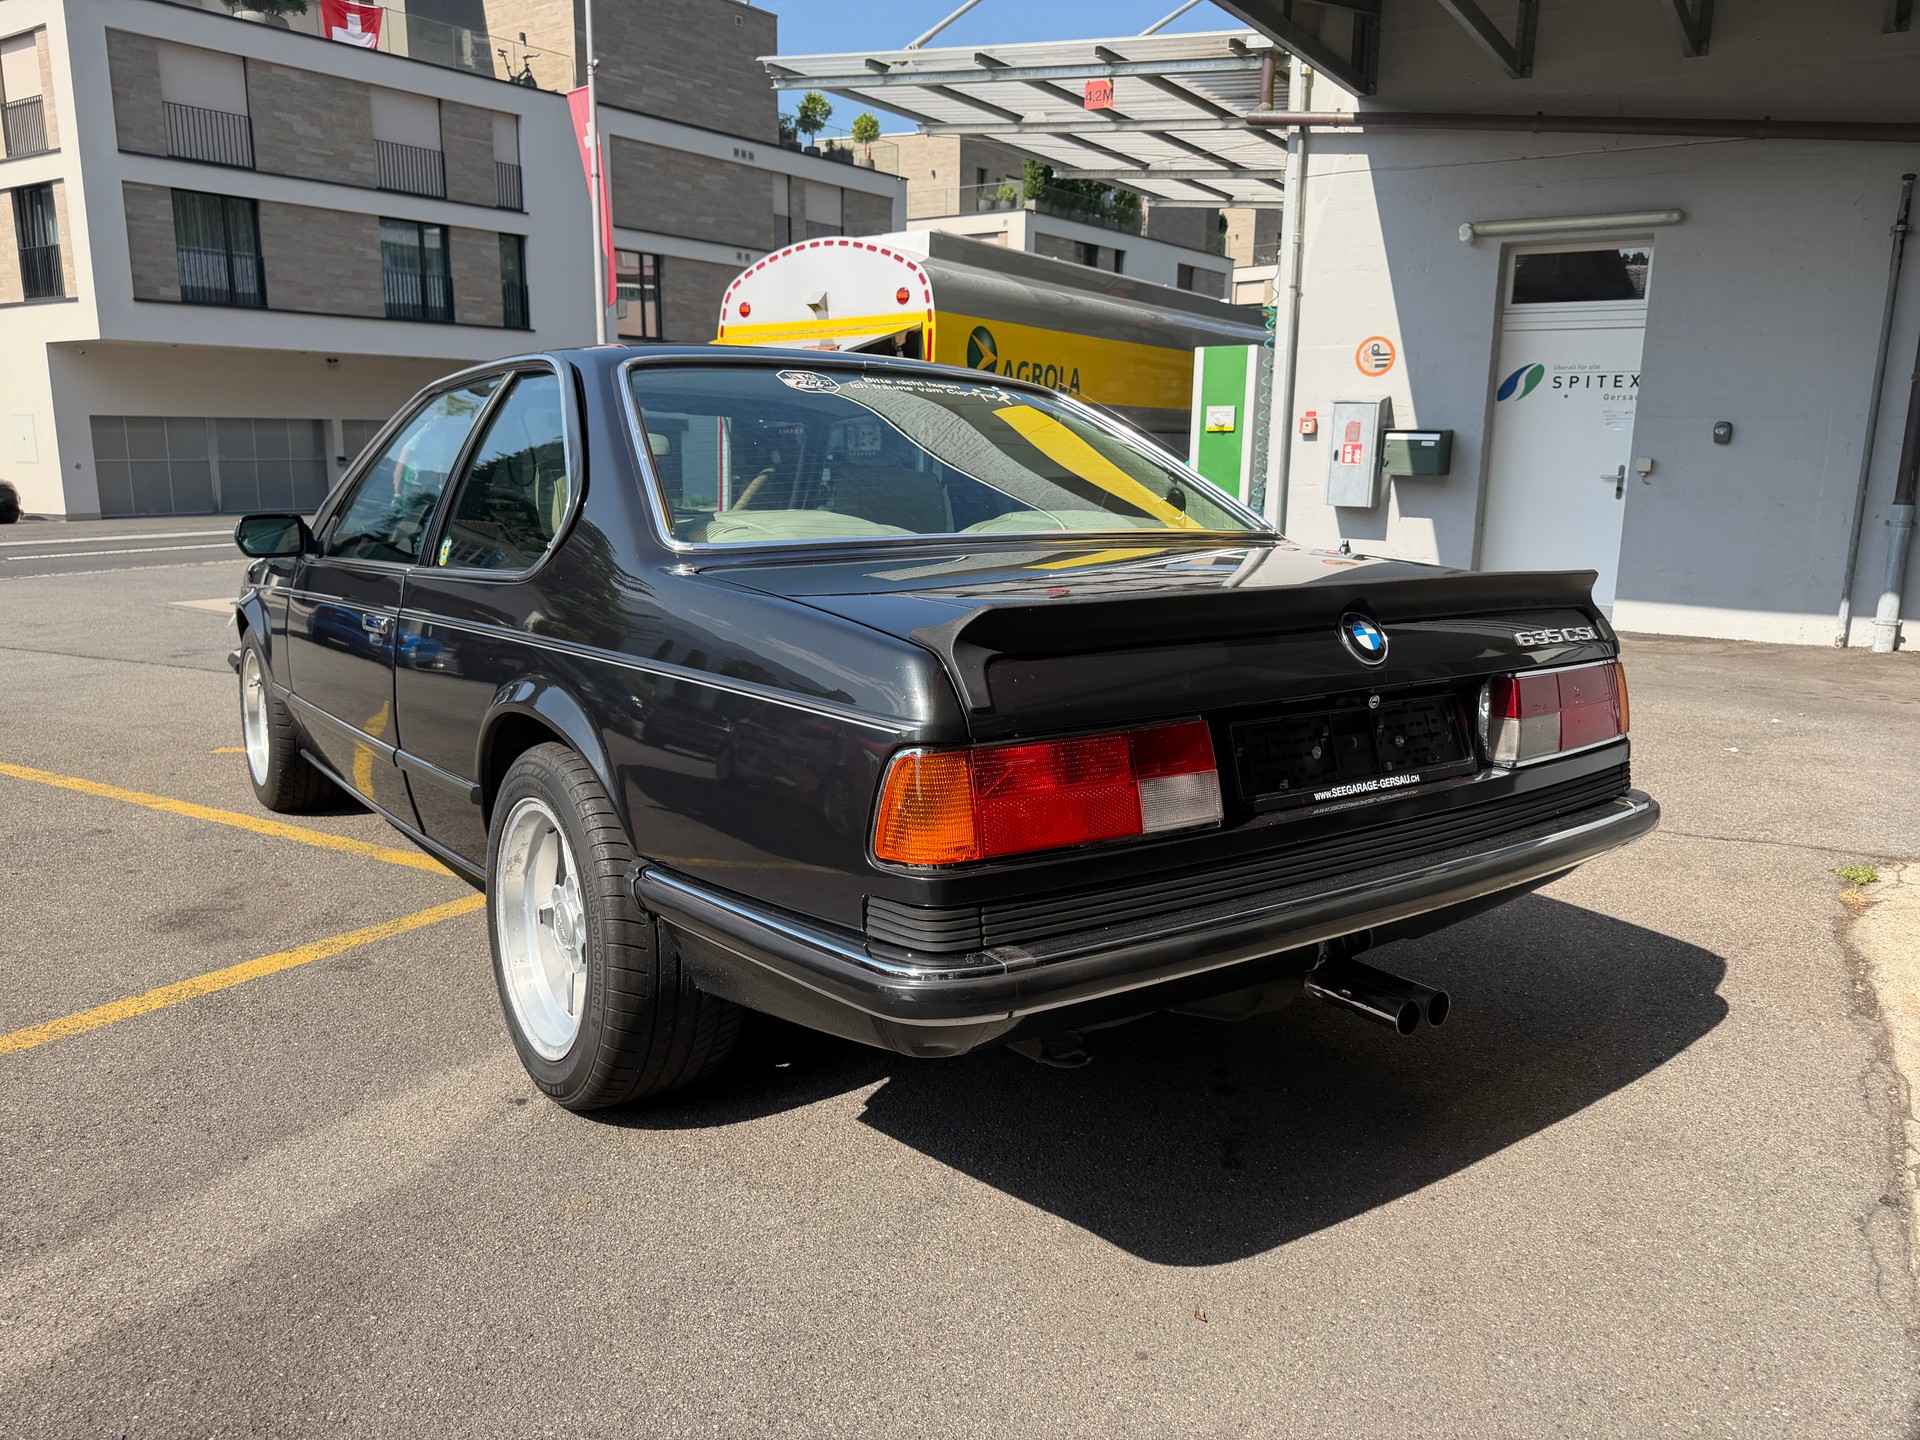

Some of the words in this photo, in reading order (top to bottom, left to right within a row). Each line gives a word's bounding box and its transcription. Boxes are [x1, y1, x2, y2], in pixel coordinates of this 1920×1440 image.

[1086, 89, 1113, 102] 4.2M
[863, 377, 892, 385] Bitte
[896, 379, 923, 387] nicht
[926, 381, 961, 390] hupen
[1003, 360, 1080, 394] AGROLA
[1552, 374, 1640, 389] SPITEX
[849, 382, 869, 390] Ich
[872, 383, 914, 392] träume
